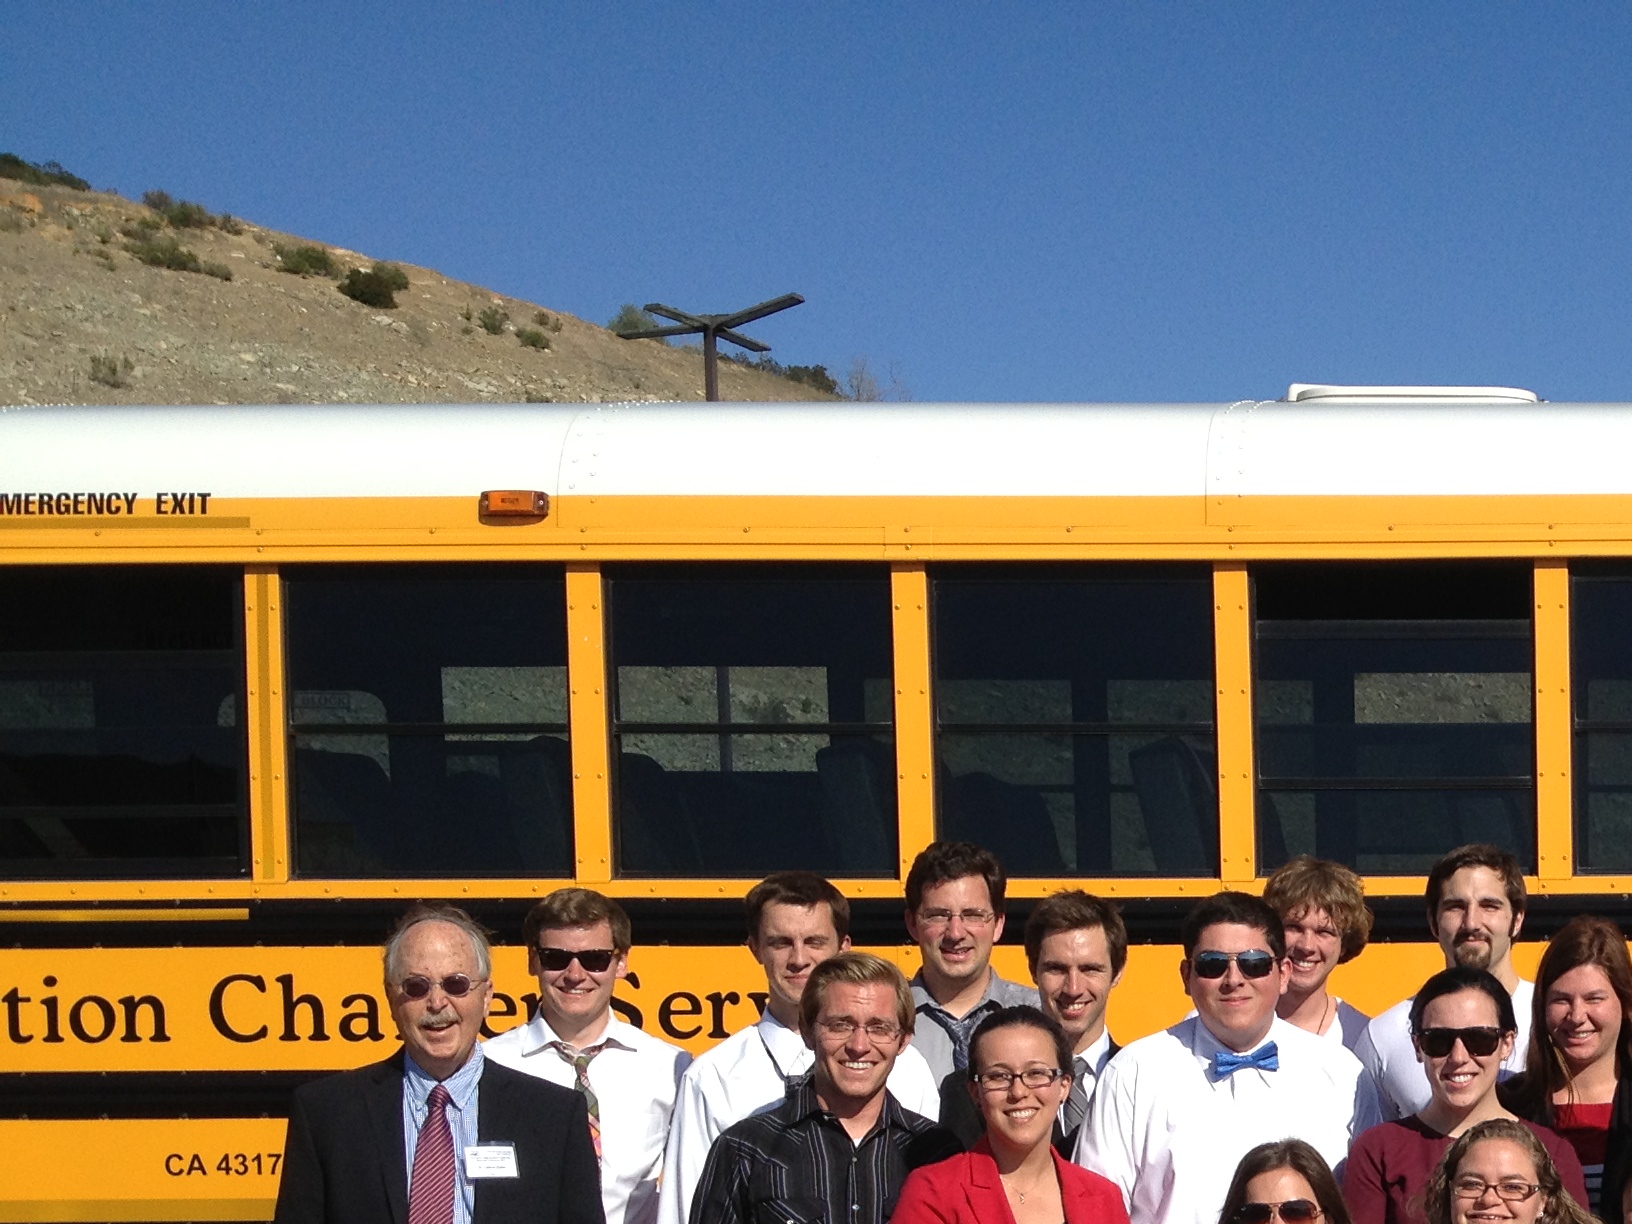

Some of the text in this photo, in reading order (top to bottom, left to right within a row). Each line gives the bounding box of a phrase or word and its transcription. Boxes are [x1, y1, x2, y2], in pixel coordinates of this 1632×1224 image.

[0, 492, 212, 515] MERGENCY EXIT
[2, 975, 171, 1043] tion
[165, 1153, 282, 1176] CA 4317
